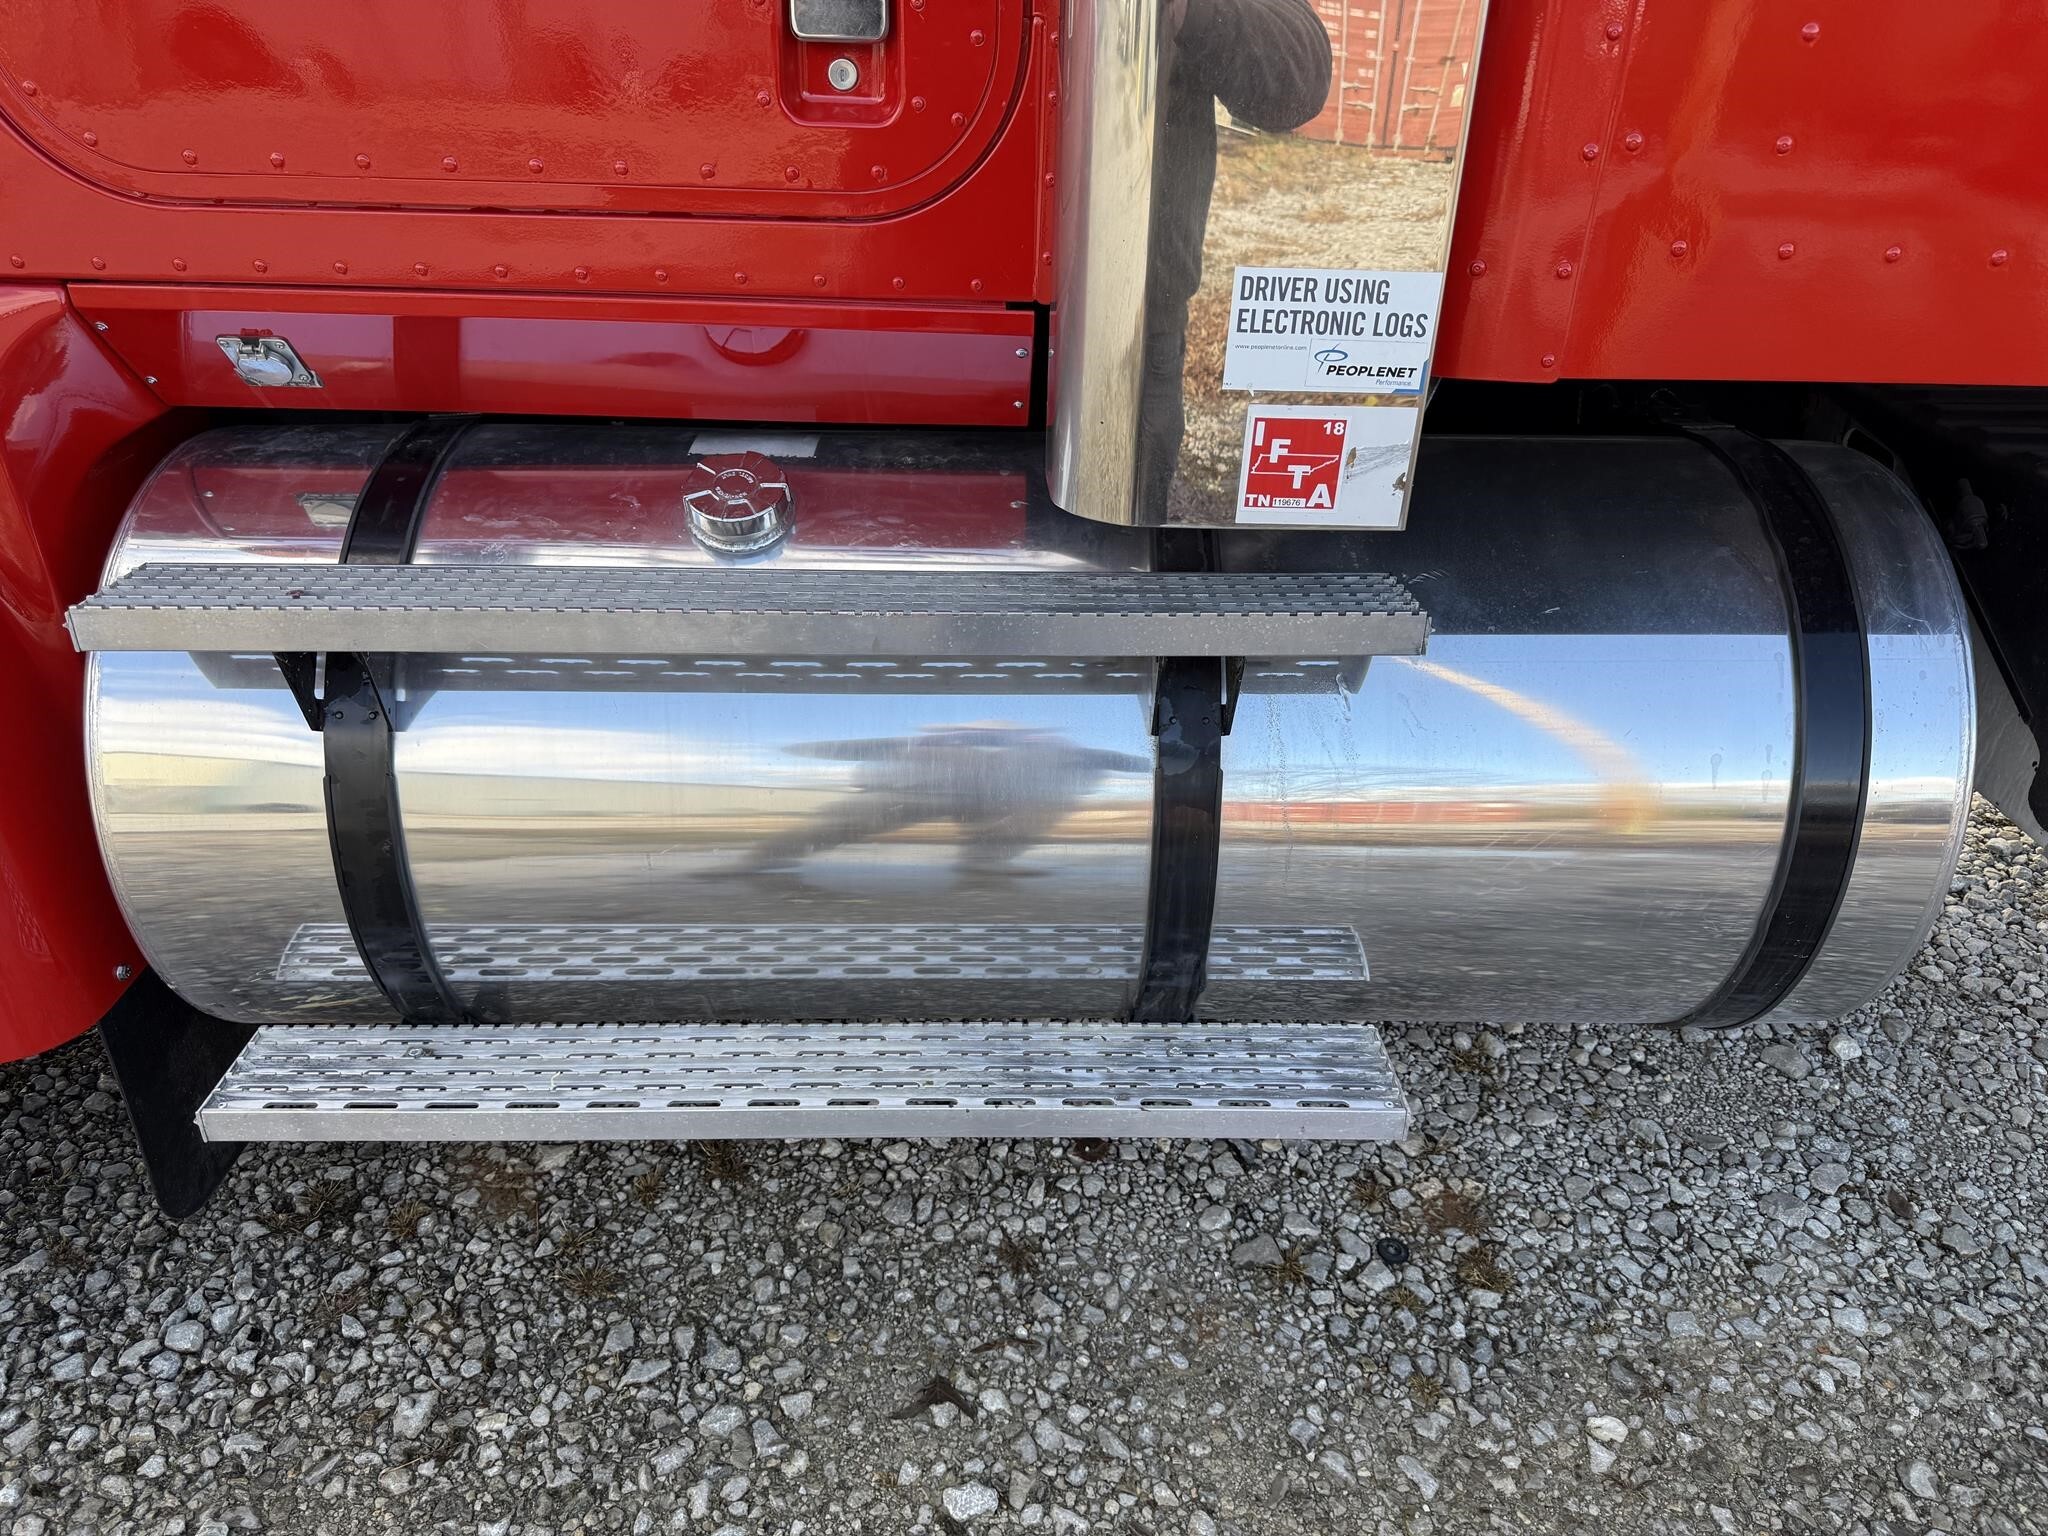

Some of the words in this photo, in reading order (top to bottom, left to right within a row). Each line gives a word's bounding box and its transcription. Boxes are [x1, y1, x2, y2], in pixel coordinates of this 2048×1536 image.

[1239, 275, 1318, 303] DRIVER
[1324, 278, 1390, 305] USING
[1236, 308, 1366, 337] ELECTRONIC
[1372, 312, 1428, 338] LOGS
[1325, 365, 1417, 378] PEOPLENET
[1323, 421, 1345, 436] 18
[1246, 494, 1271, 507] TN
[1273, 498, 1301, 507] 119676
